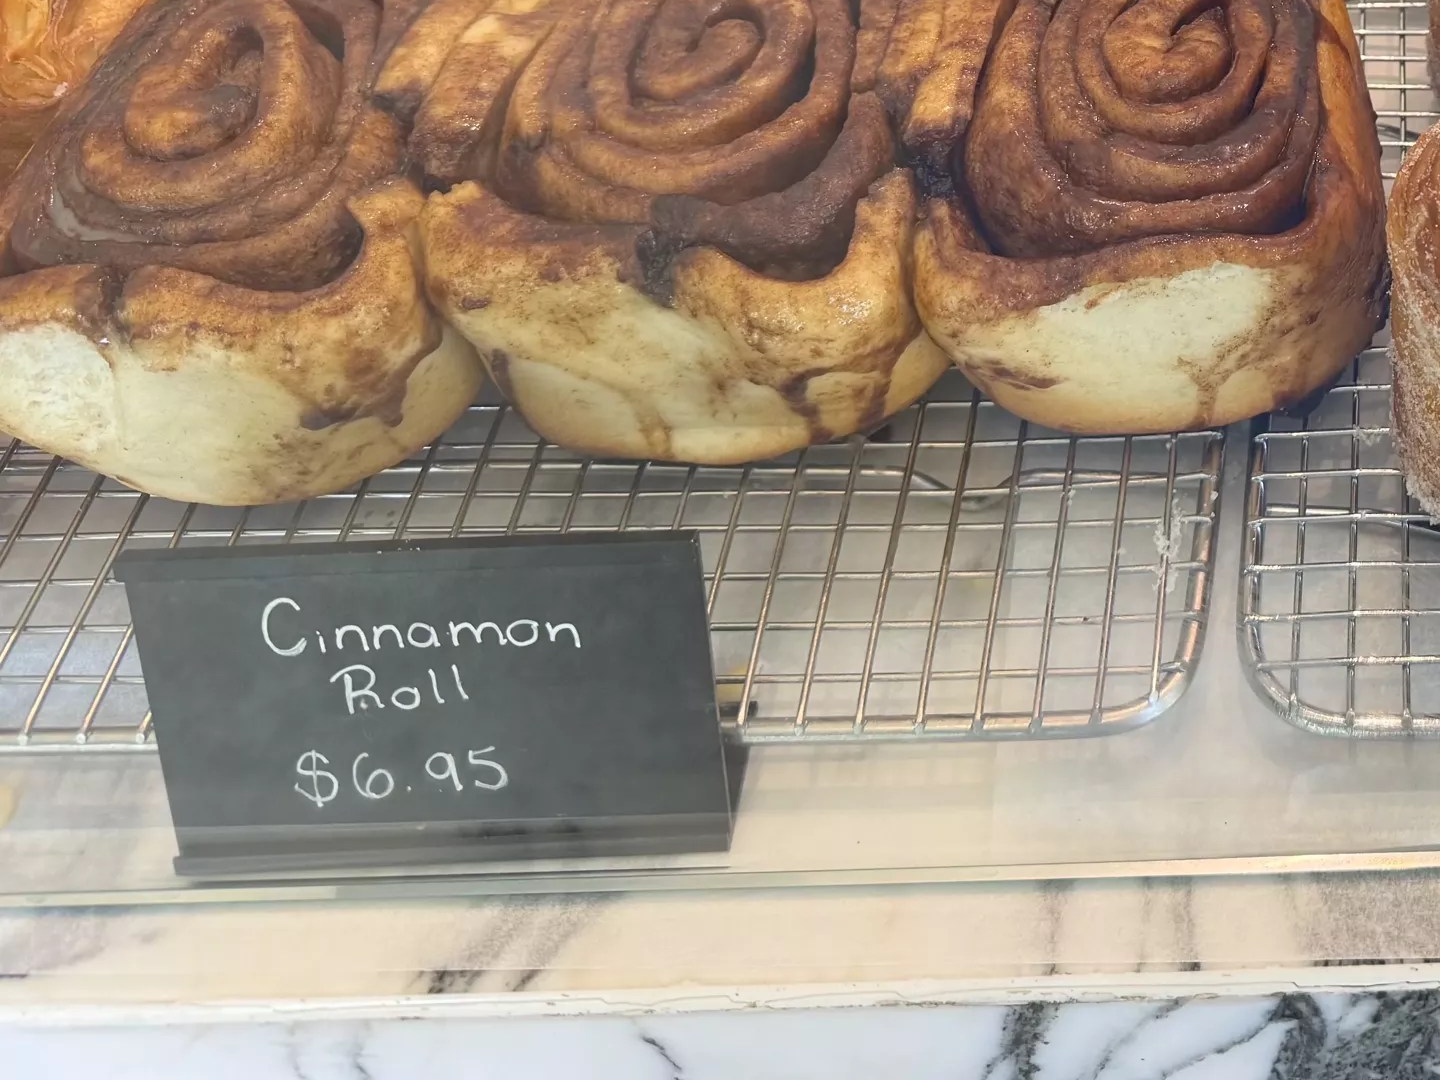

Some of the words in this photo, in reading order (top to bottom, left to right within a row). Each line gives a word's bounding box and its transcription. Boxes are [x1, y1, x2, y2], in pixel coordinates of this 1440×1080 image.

[261, 596, 582, 656] Cinnamon
[329, 663, 469, 715] Roll
[294, 745, 508, 807] $6.95
